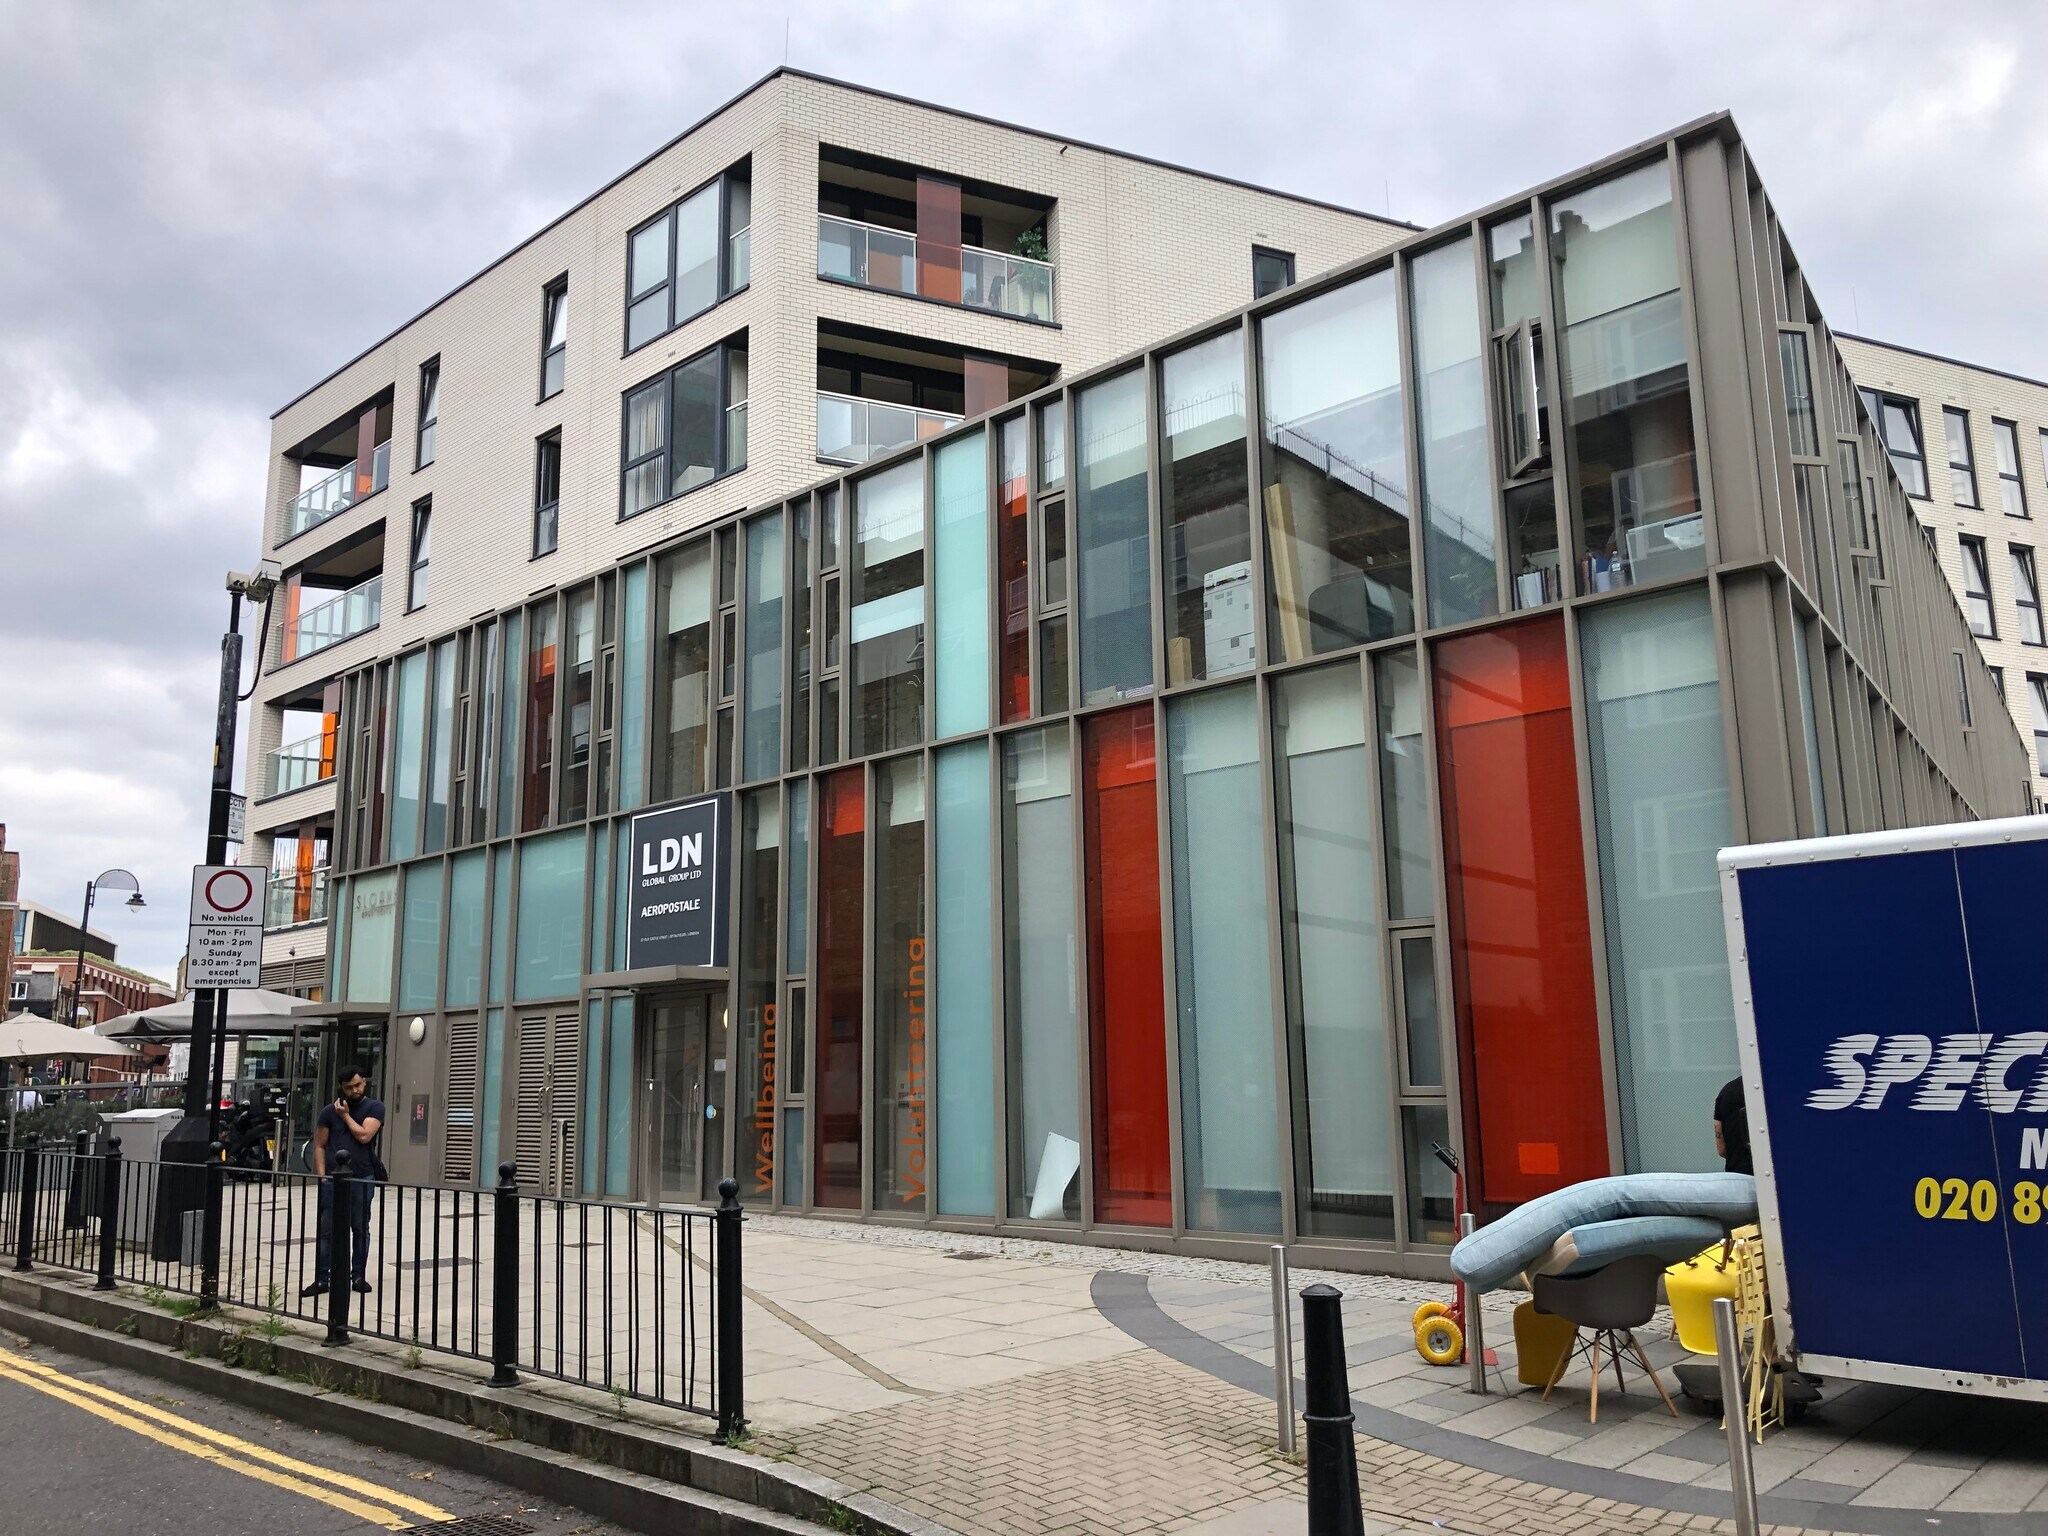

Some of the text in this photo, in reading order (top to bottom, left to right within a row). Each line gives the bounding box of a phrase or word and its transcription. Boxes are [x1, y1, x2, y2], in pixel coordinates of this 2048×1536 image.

[642, 832, 703, 876] LDN
[642, 869, 702, 888] GLOBAL GROUP LTD
[641, 898, 701, 918] AEROPOSTALE
[201, 914, 254, 922] No vehicles
[198, 938, 209, 946] 10
[231, 938, 238, 946] 2
[208, 949, 242, 957] Sunday
[191, 959, 214, 967] 8.30
[243, 960, 257, 968] pm
[208, 969, 239, 977] except
[194, 978, 252, 986] emergencies
[901, 937, 926, 1203] Volunteering
[1914, 1176, 1998, 1222] 020
